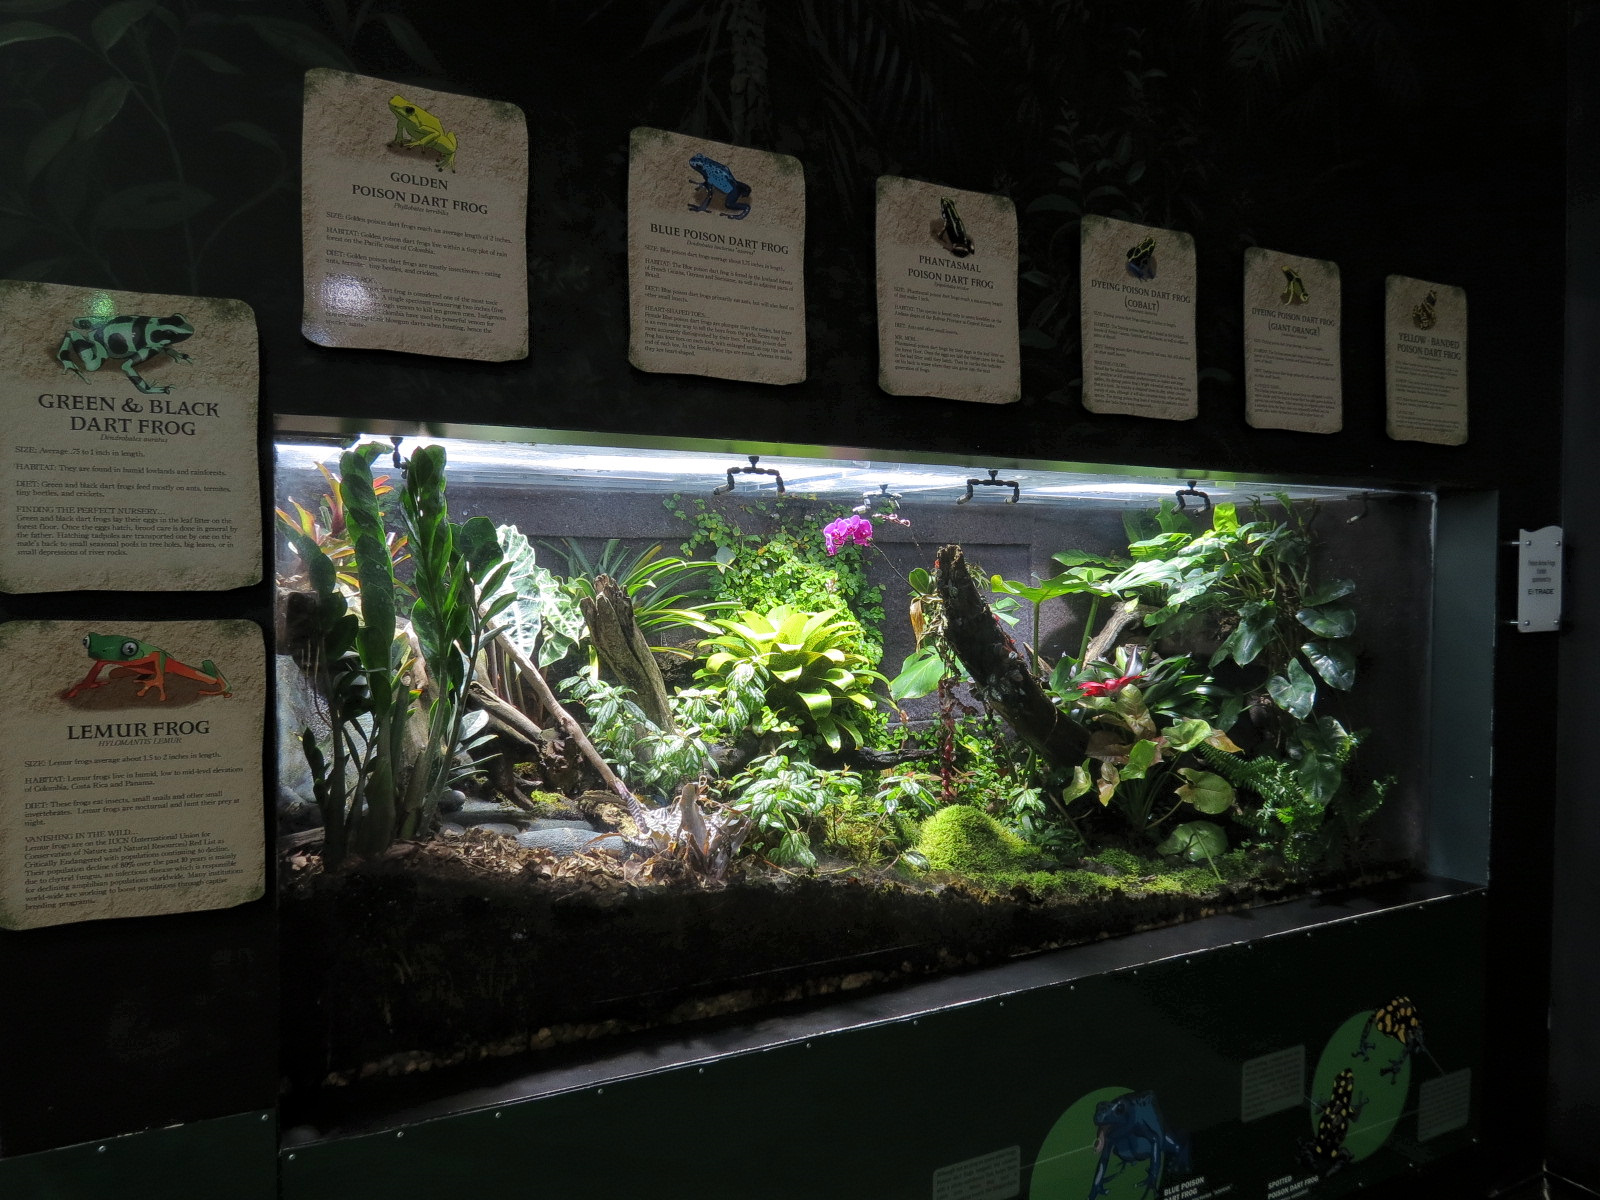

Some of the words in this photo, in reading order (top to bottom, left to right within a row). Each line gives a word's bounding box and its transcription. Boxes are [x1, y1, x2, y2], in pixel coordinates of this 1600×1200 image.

[391, 172, 448, 190] GOLDEN
[352, 184, 406, 202] POISON
[411, 193, 448, 208] DART
[453, 200, 488, 214] FROG
[326, 211, 344, 219] SIZE:
[345, 213, 366, 222] Golden
[401, 221, 416, 230] frogs
[442, 229, 463, 237] average
[464, 230, 481, 239] length
[364, 239, 383, 247] Pacific
[650, 223, 680, 236] BLUE
[683, 229, 725, 244] POISON
[729, 236, 758, 249] DART
[762, 241, 788, 254] FROG
[920, 255, 981, 273] PHANTASMAL
[908, 268, 942, 281] POISON
[945, 274, 968, 285] DART
[971, 278, 994, 289] FROG
[1092, 280, 1120, 291] DYEING
[1122, 284, 1149, 296] POISON
[1151, 290, 1170, 300] DART
[1172, 294, 1190, 303] FROG
[1125, 296, 1159, 312] (COBALT)
[1252, 308, 1276, 318] DYEING
[1278, 312, 1300, 321] POISON
[1302, 315, 1318, 324] DART
[1320, 318, 1336, 327] FROG
[1268, 320, 1290, 332] (GIANT
[1399, 332, 1426, 344] YELLOW
[1431, 338, 1460, 349] BANDED
[1397, 344, 1422, 355] POISON
[1424, 348, 1442, 357] DART
[1444, 351, 1461, 360] FROG
[38, 394, 116, 412] GREEN
[121, 398, 143, 413] &
[149, 400, 220, 418] BLACK
[70, 416, 132, 433] DART
[138, 419, 196, 435] FROG
[40, 447, 68, 456] Average
[121, 450, 145, 458] length.
[59, 465, 76, 473] They
[117, 483, 135, 491] frogs
[67, 722, 148, 740] LEMUR
[153, 720, 209, 736] FROG
[199, 751, 222, 759] length.
[25, 775, 66, 784] HABITAT:
[182, 767, 211, 775] mid-level
[1164, 1184, 1180, 1196] BLUE
[1181, 1176, 1205, 1190] POISON
[1268, 1175, 1292, 1190] SPOTTED
[1268, 1187, 1289, 1199] POISON
[1290, 1180, 1304, 1191] DART
[1304, 1175, 1319, 1186] FROG
[1181, 1187, 1198, 1199] FROG
